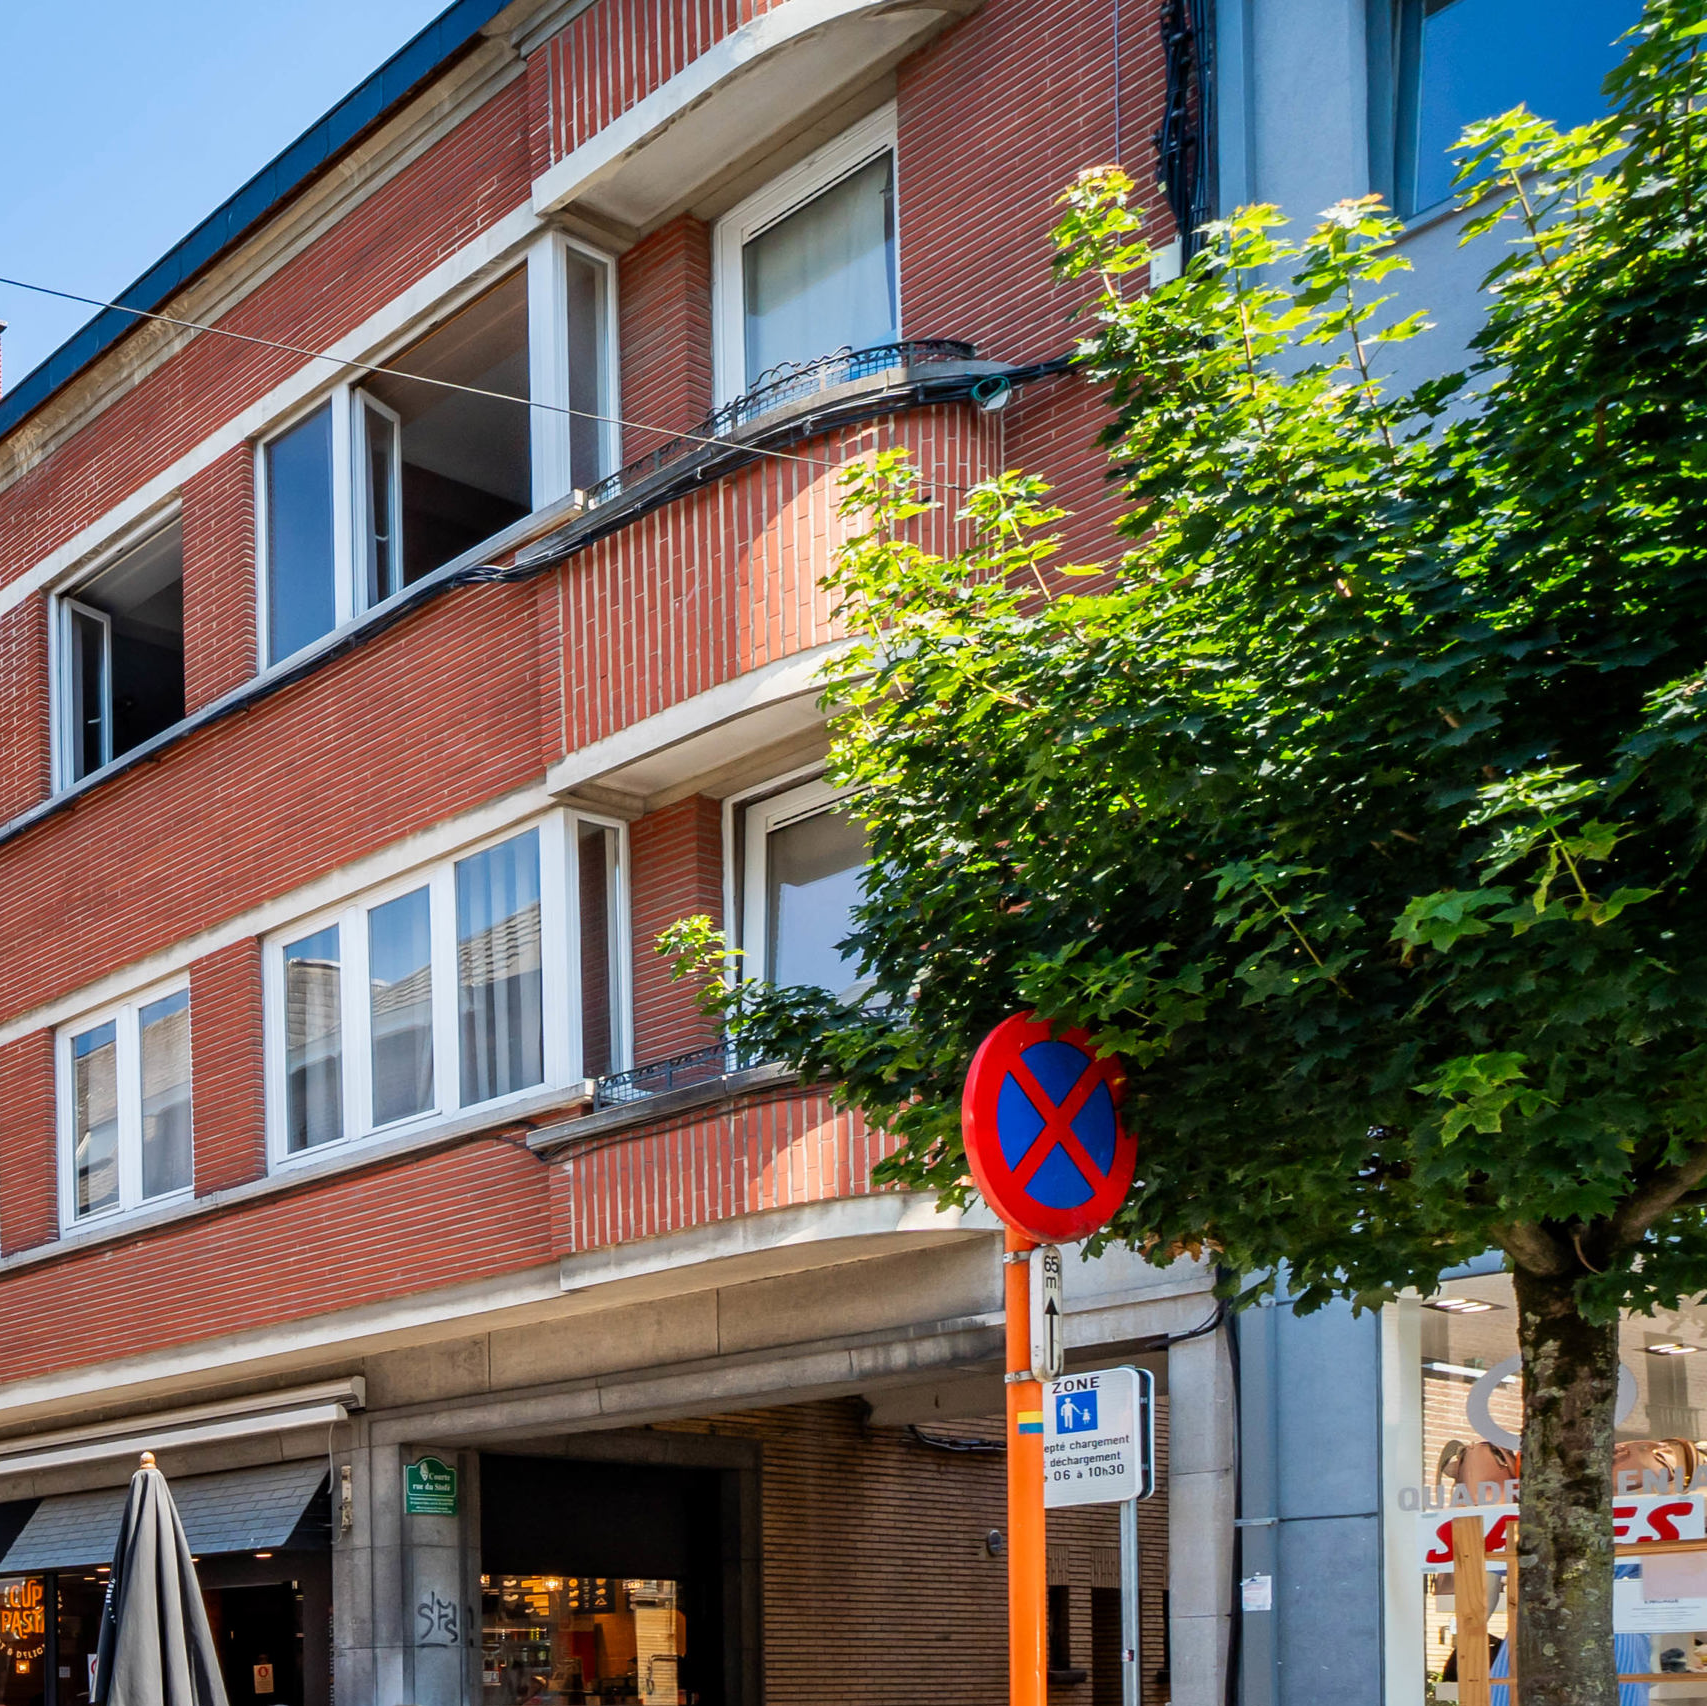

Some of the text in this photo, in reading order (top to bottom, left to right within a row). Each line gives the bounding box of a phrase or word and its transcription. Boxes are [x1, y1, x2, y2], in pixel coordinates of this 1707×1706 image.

[1044, 1255, 1059, 1273] 65
[1046, 1276, 1057, 1289] m
[1052, 1376, 1100, 1394] ZONE
[1044, 1434, 1130, 1454] epté chargement
[1050, 1451, 1121, 1468] déchargement
[1054, 1463, 1125, 1481] 06 à 10h30
[413, 1483, 423, 1491] rue
[425, 1482, 433, 1491] du
[1425, 1501, 1694, 1564] SAES
